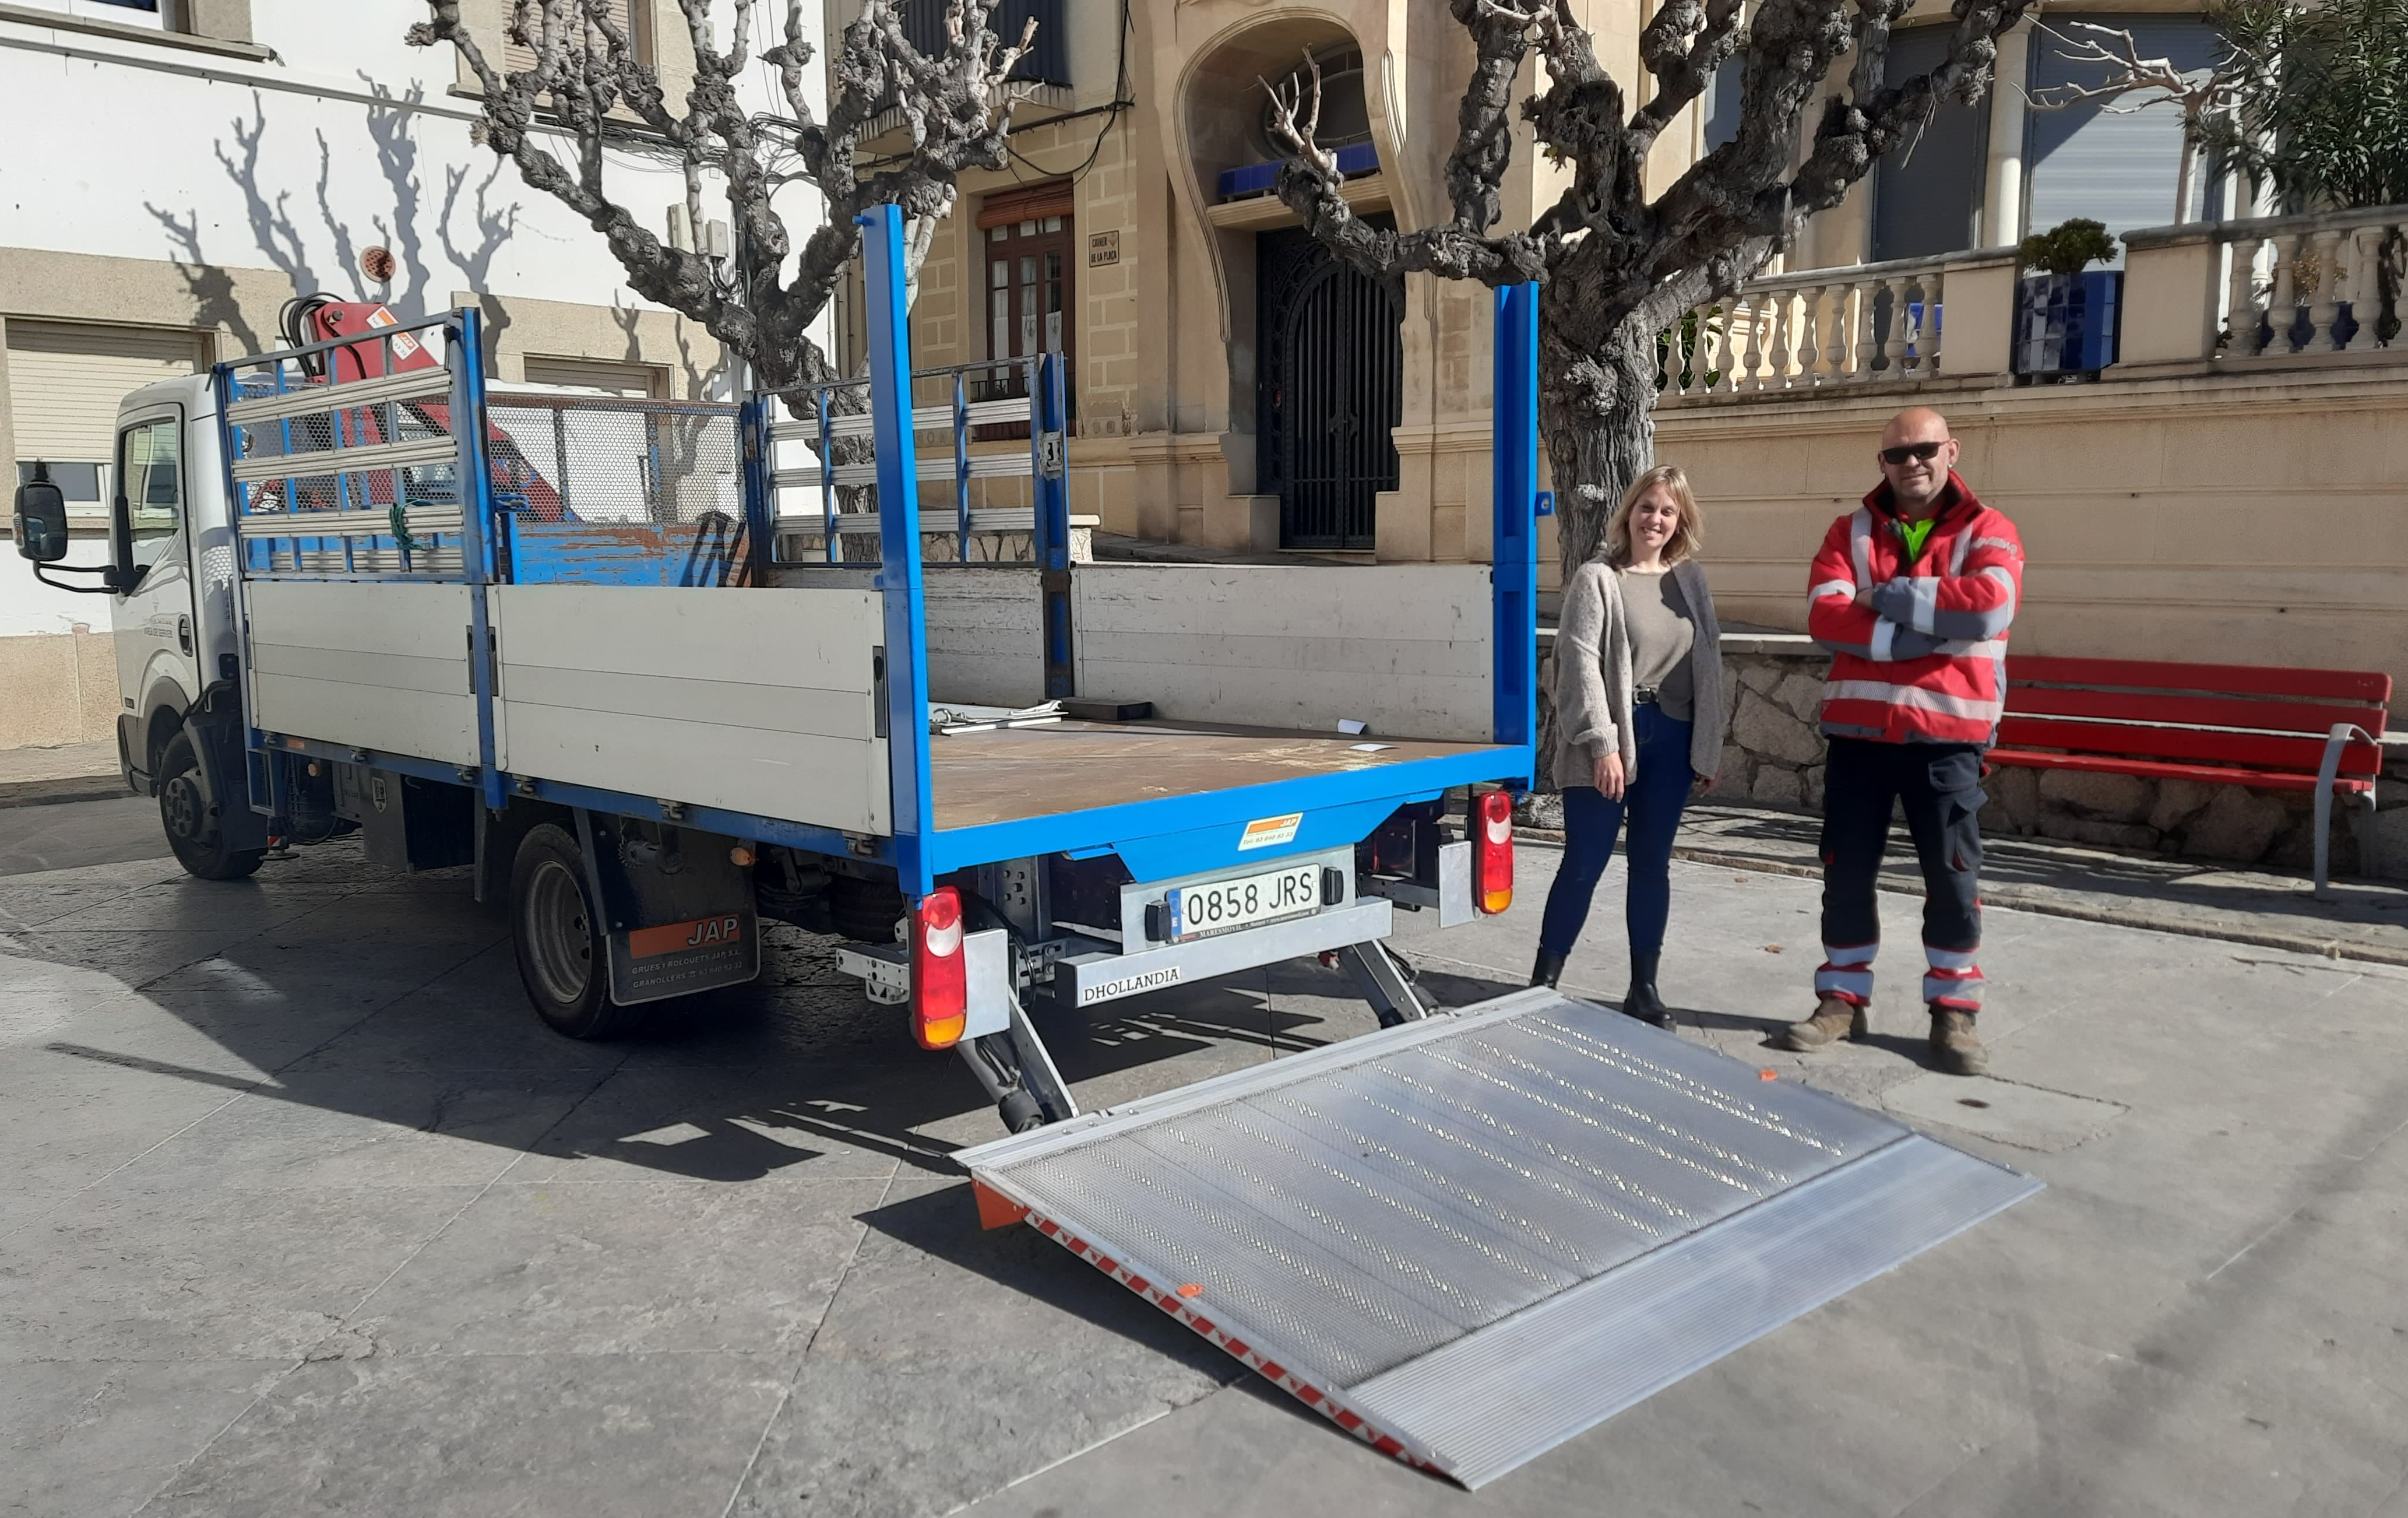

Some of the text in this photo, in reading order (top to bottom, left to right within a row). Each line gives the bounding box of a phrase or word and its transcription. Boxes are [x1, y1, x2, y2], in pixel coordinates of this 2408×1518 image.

[1093, 237, 1107, 247] CARRER
[1091, 250, 1117, 263] DE LA PLAÇA
[1280, 818, 1297, 827] JAP
[1188, 872, 1312, 925] 0858 JRS
[1171, 917, 1178, 927] E
[687, 918, 738, 946] JAP
[632, 963, 660, 975] GRUES
[633, 973, 687, 988] GRANOLLERS
[1084, 968, 1179, 1002] DHOLLANDIA
